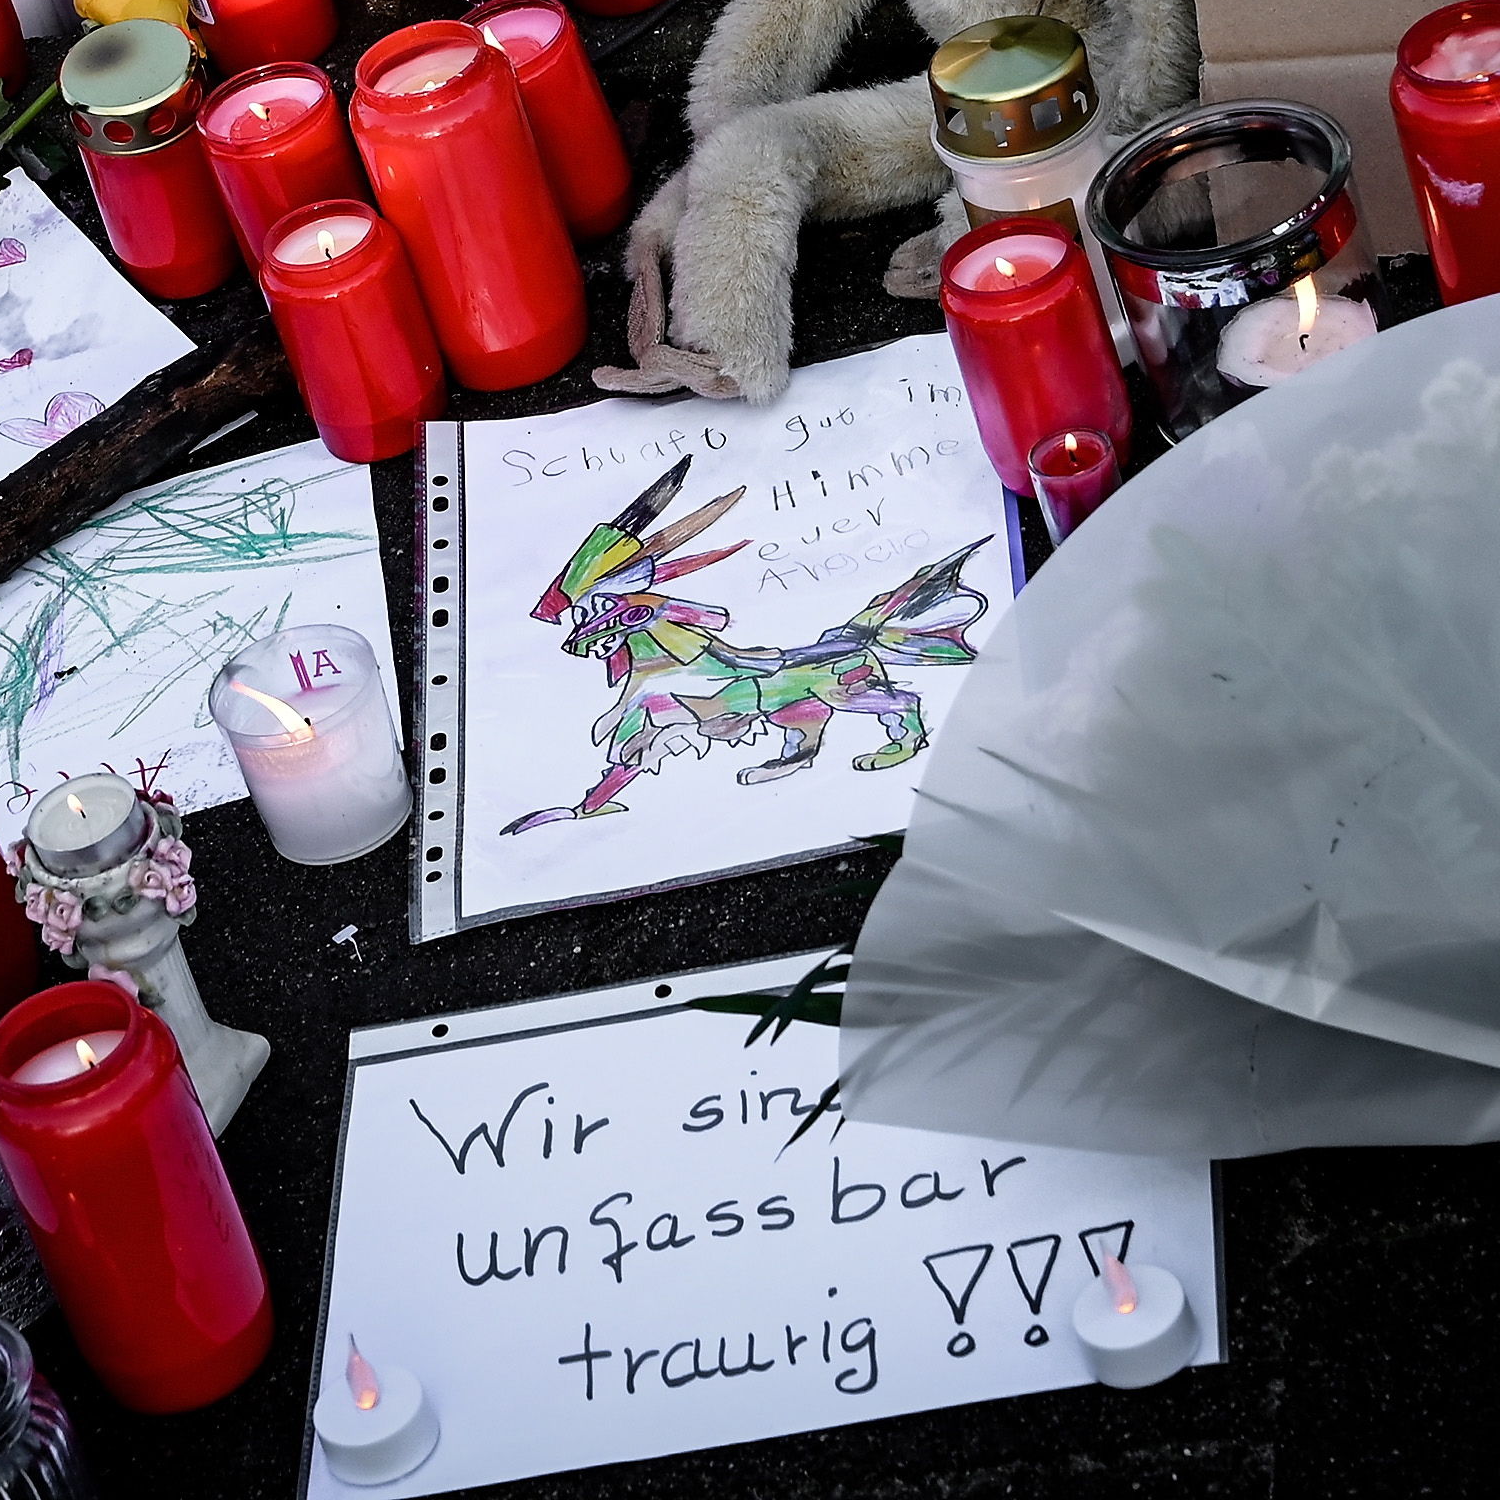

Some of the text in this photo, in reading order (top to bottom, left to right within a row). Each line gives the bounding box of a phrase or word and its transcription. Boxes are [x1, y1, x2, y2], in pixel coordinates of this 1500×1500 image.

[784, 406, 855, 452] gut
[772, 439, 960, 512] Himme
[409, 1068, 843, 1175] Wir sin
[557, 1287, 879, 1402] traurig
